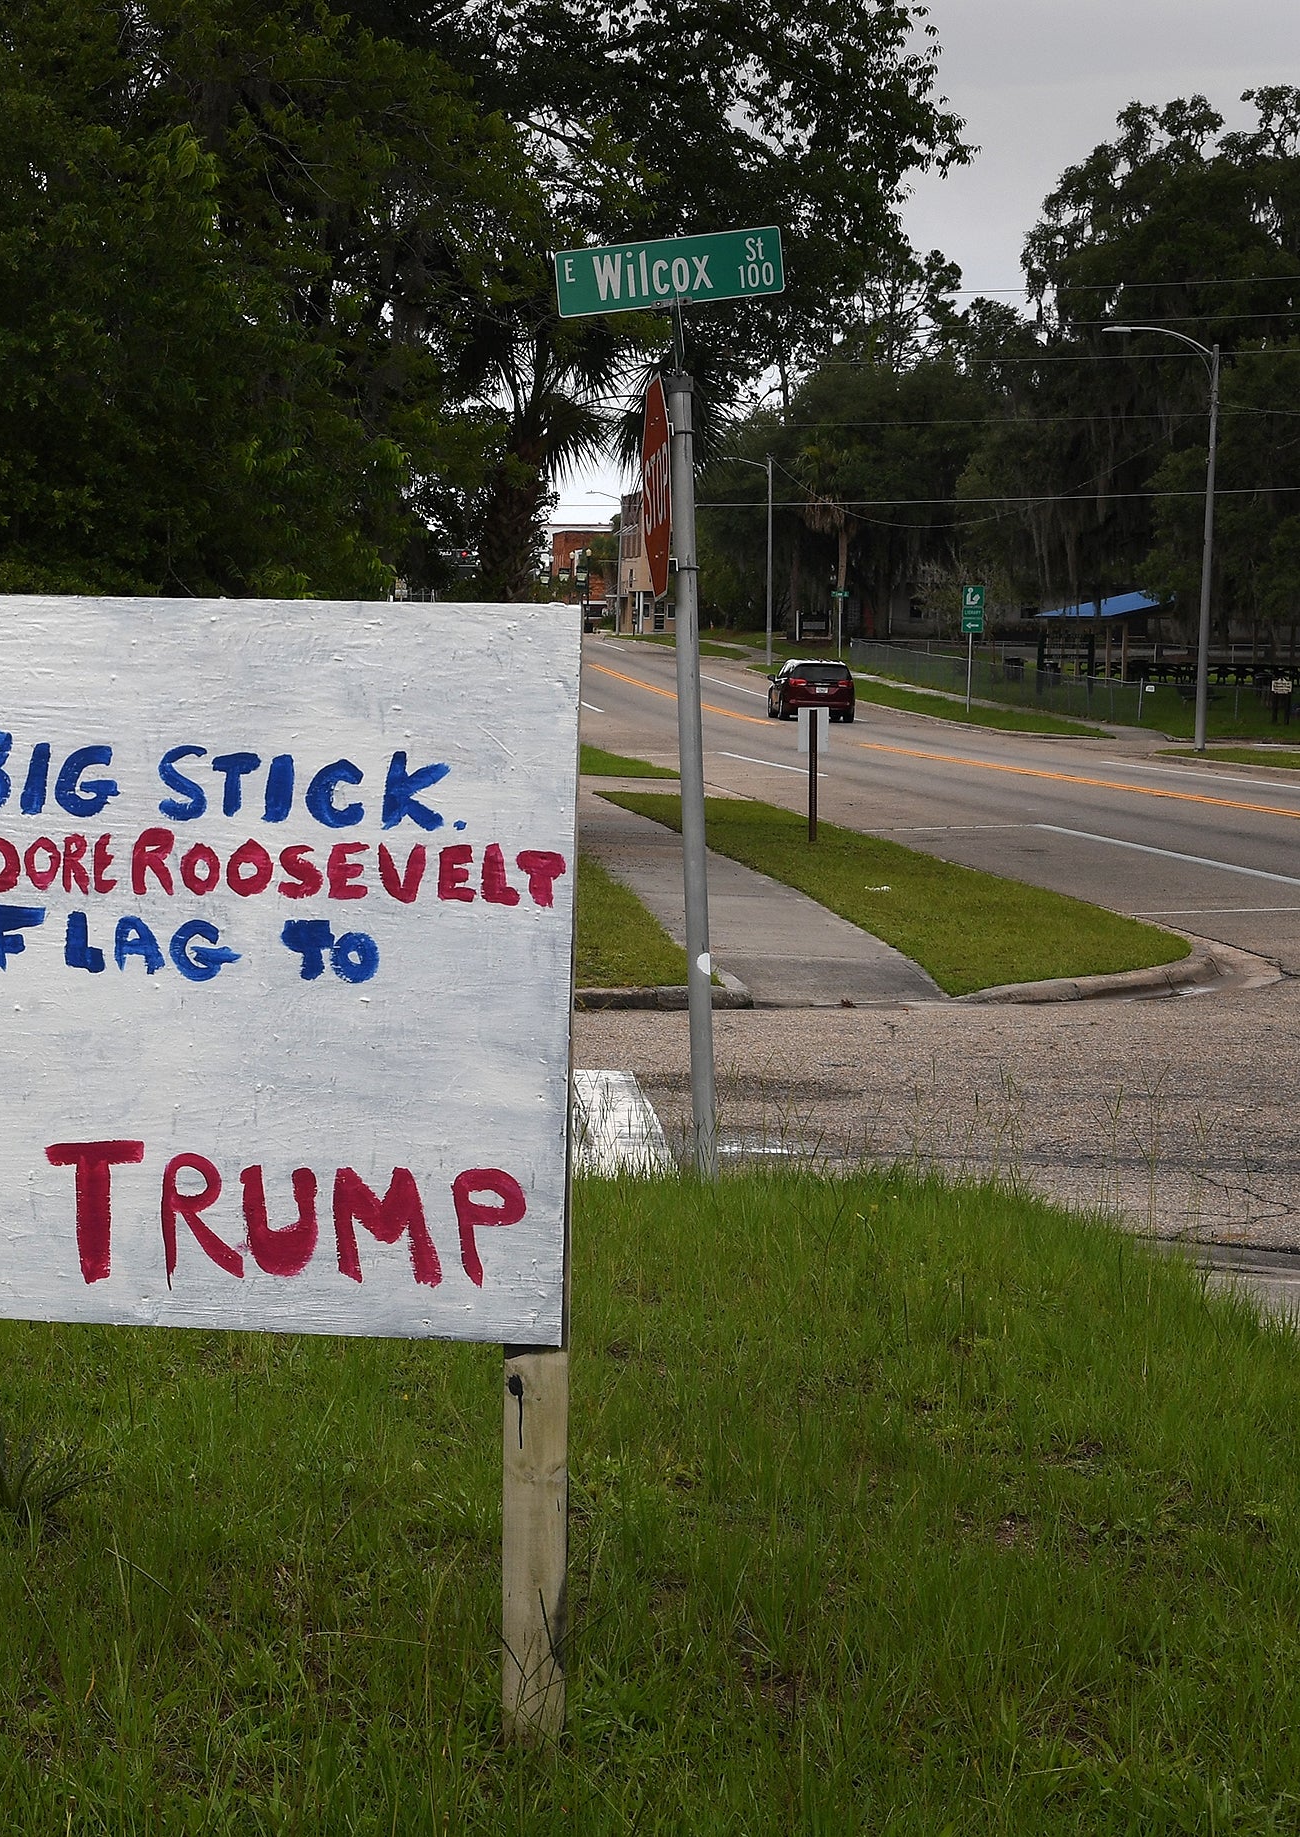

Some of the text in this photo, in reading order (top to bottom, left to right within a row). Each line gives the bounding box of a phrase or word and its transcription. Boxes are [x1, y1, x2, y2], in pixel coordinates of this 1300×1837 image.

[564, 249, 714, 301] E Wilcox
[738, 261, 774, 289] 100
[745, 236, 765, 262] St
[644, 441, 668, 536] STOP
[157, 744, 467, 832] STICK.
[131, 826, 568, 908] ROOSEVELT
[280, 919, 381, 985] TO
[44, 1139, 528, 1288] TRUMP
